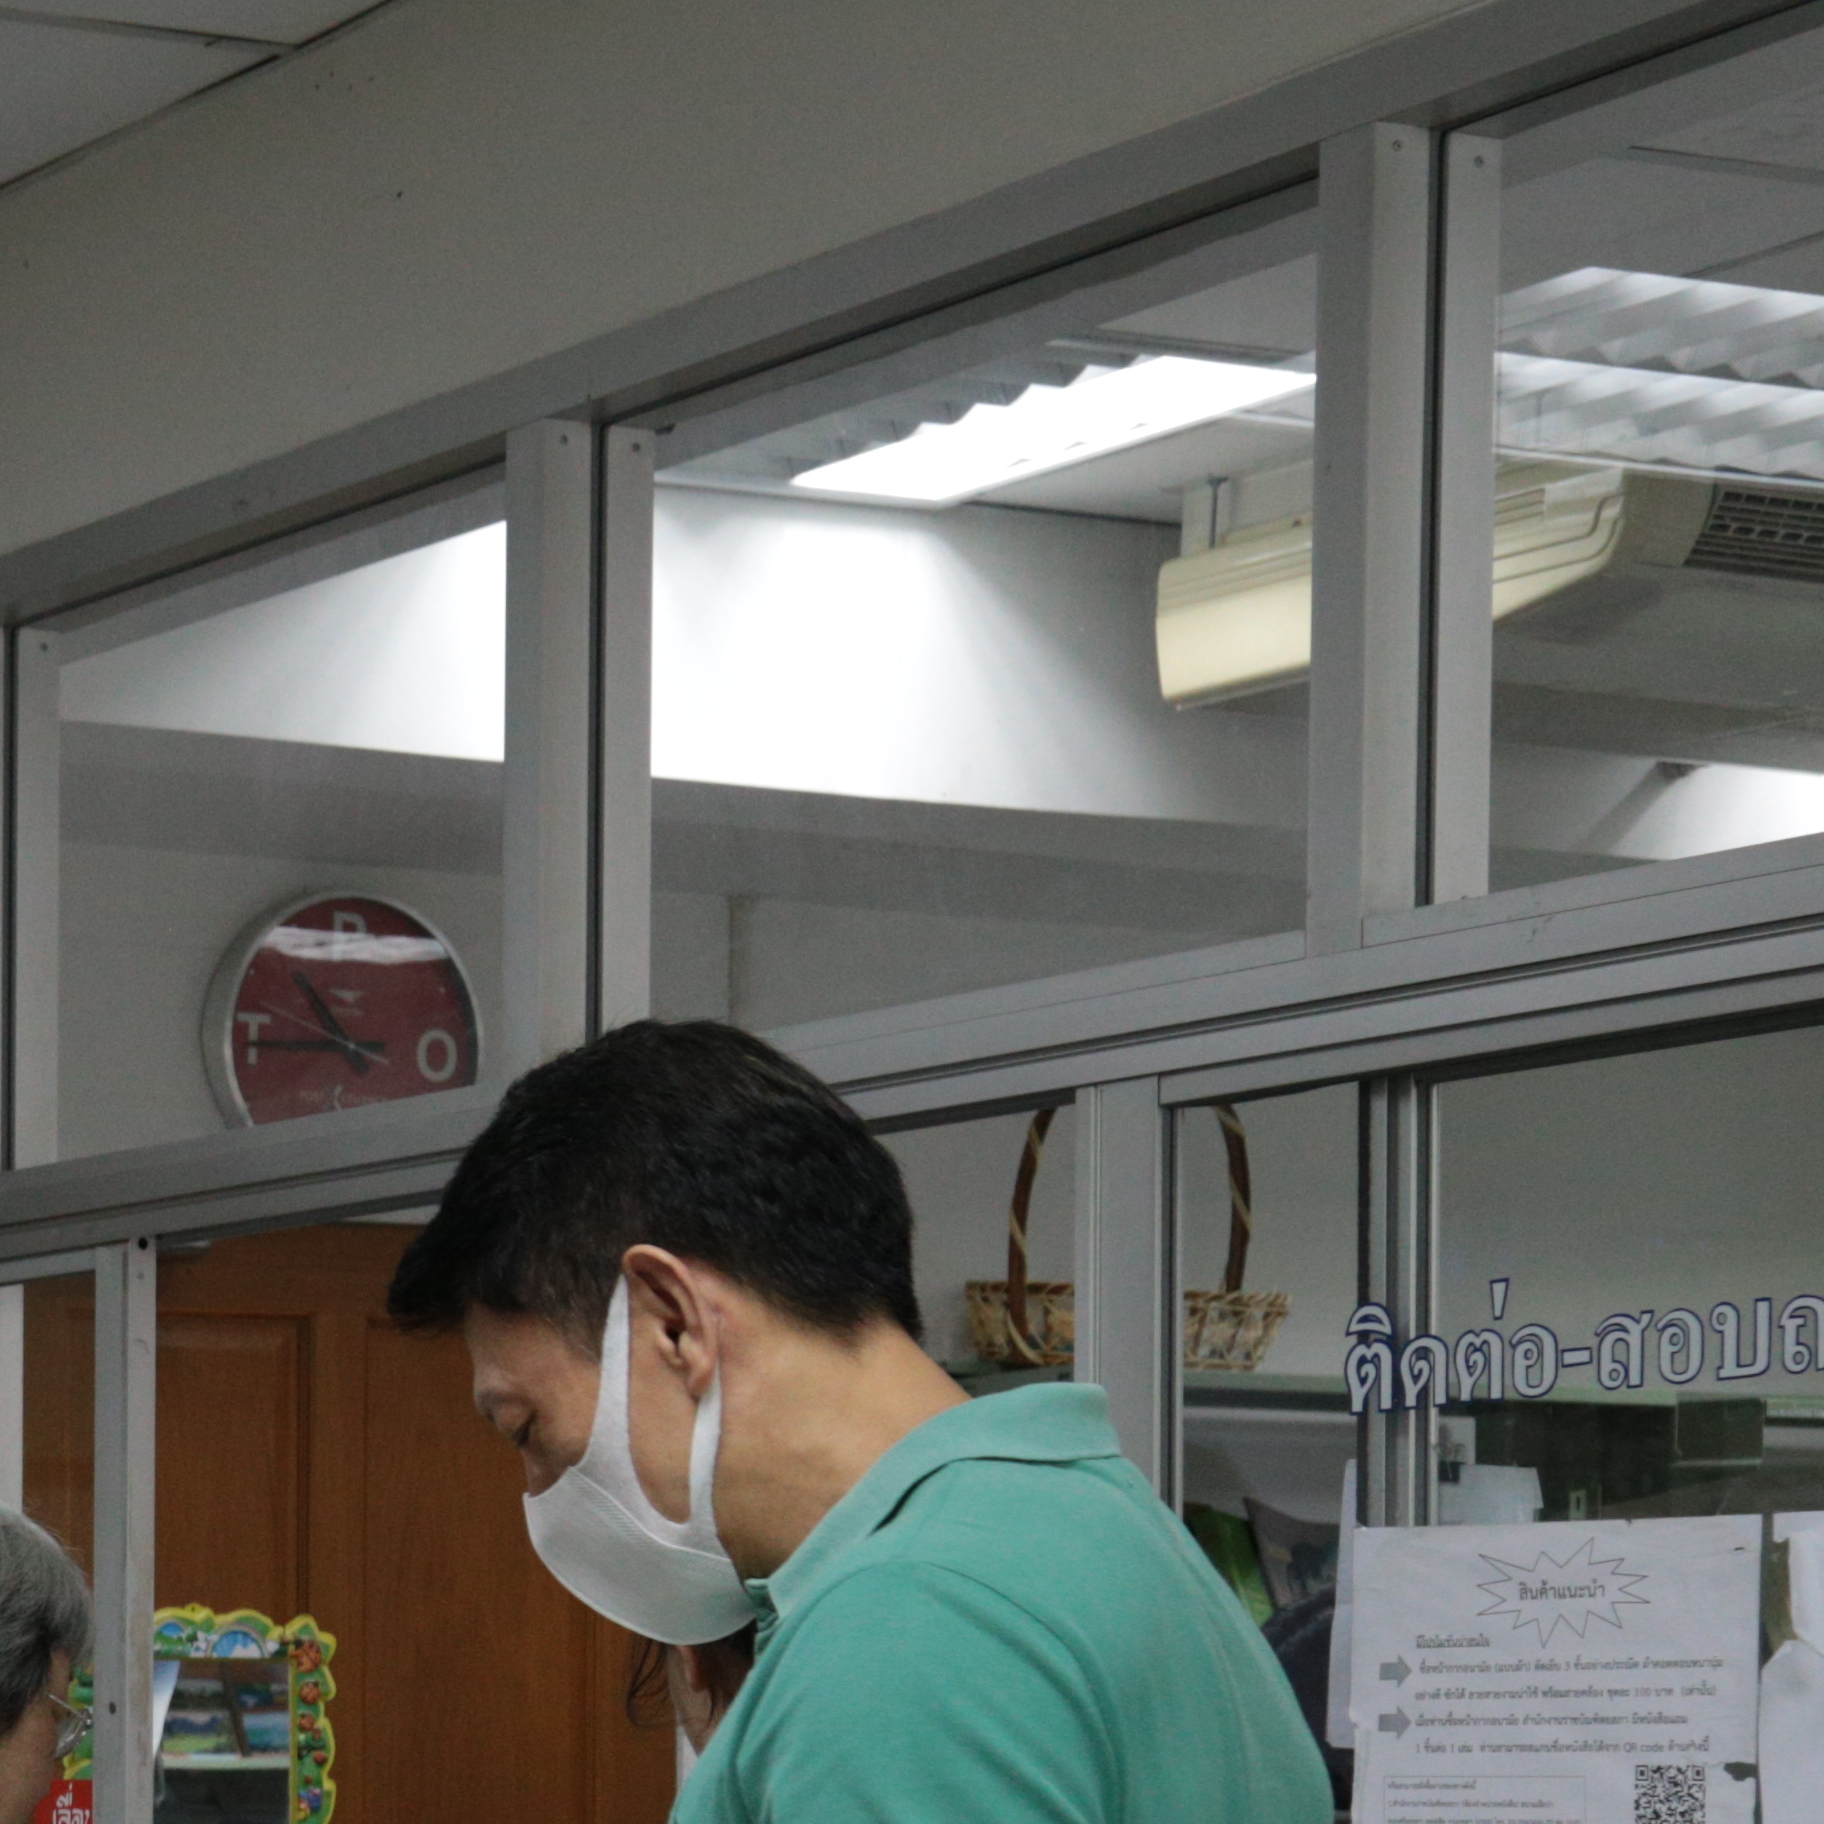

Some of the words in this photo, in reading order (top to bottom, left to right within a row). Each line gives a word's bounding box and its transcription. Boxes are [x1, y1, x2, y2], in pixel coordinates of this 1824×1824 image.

[237, 1012, 272, 1066] T
[1518, 1578, 1606, 1601] สินค้าแนะนำ
[1640, 1741, 1665, 1752] code
